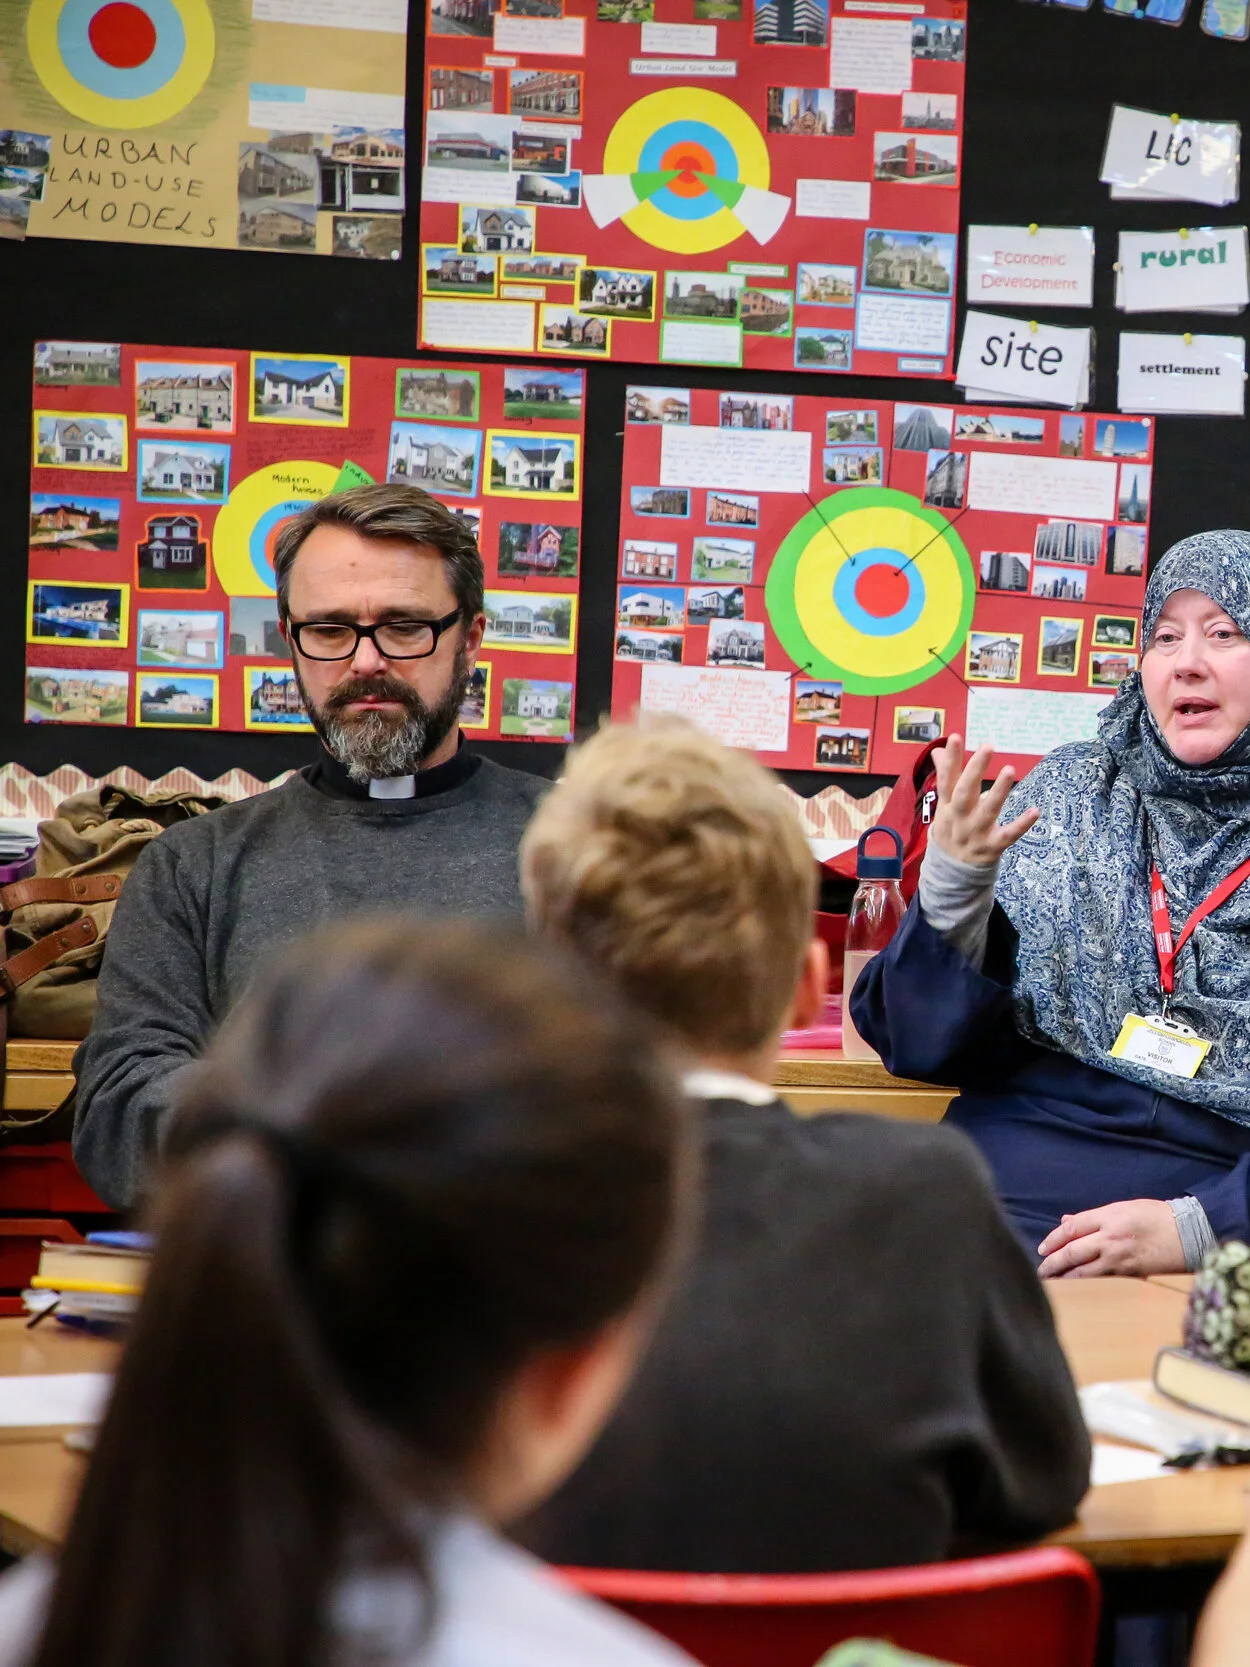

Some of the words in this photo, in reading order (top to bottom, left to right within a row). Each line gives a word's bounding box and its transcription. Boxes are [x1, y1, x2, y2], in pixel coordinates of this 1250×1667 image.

[63, 133, 198, 166] URBAN
[1144, 129, 1191, 167] LIC
[52, 197, 218, 238] MODELS
[993, 250, 1068, 267] Economic
[1139, 240, 1229, 270] rural
[980, 272, 1079, 291] Development
[1139, 362, 1222, 377] settlement
[1147, 1051, 1173, 1065] VISITOR
